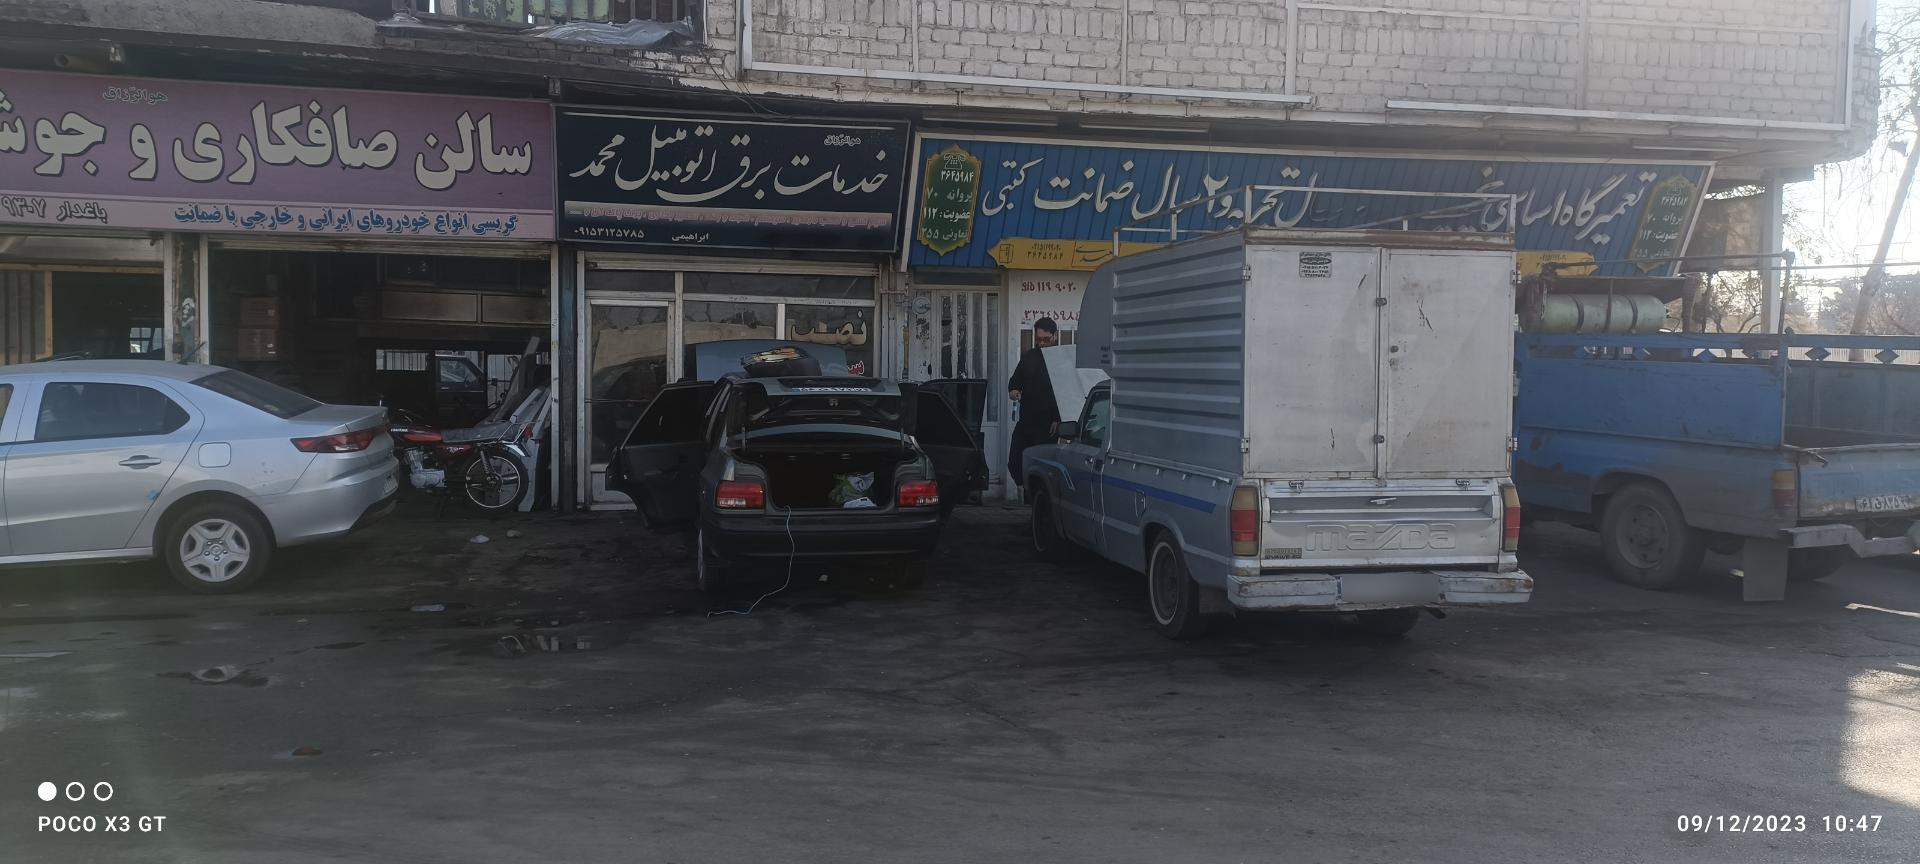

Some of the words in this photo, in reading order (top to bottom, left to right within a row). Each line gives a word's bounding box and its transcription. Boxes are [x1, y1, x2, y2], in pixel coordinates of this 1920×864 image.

[129, 123, 157, 180] و
[173, 100, 398, 184] صافکاری
[415, 110, 532, 190] سالن
[569, 134, 625, 178] محمد
[614, 124, 717, 191] اتومبیل
[656, 134, 771, 203] برق
[774, 150, 888, 195] خدمات
[1034, 160, 1134, 213] ضمانت
[981, 158, 1045, 217] کتبی
[56, 201, 109, 224] باغدار
[174, 204, 223, 223] ضمانت
[225, 206, 236, 227] با
[240, 207, 292, 229] خارجی
[297, 214, 305, 231] و
[309, 208, 352, 231] ایرانی
[357, 210, 430, 233] خودروهای
[434, 213, 468, 234] انواع
[574, 226, 645, 239] ۰۹۱۵۳۱۲۵۷۸۵
[671, 232, 709, 243] ابراهیمی
[790, 310, 867, 345] نصب
